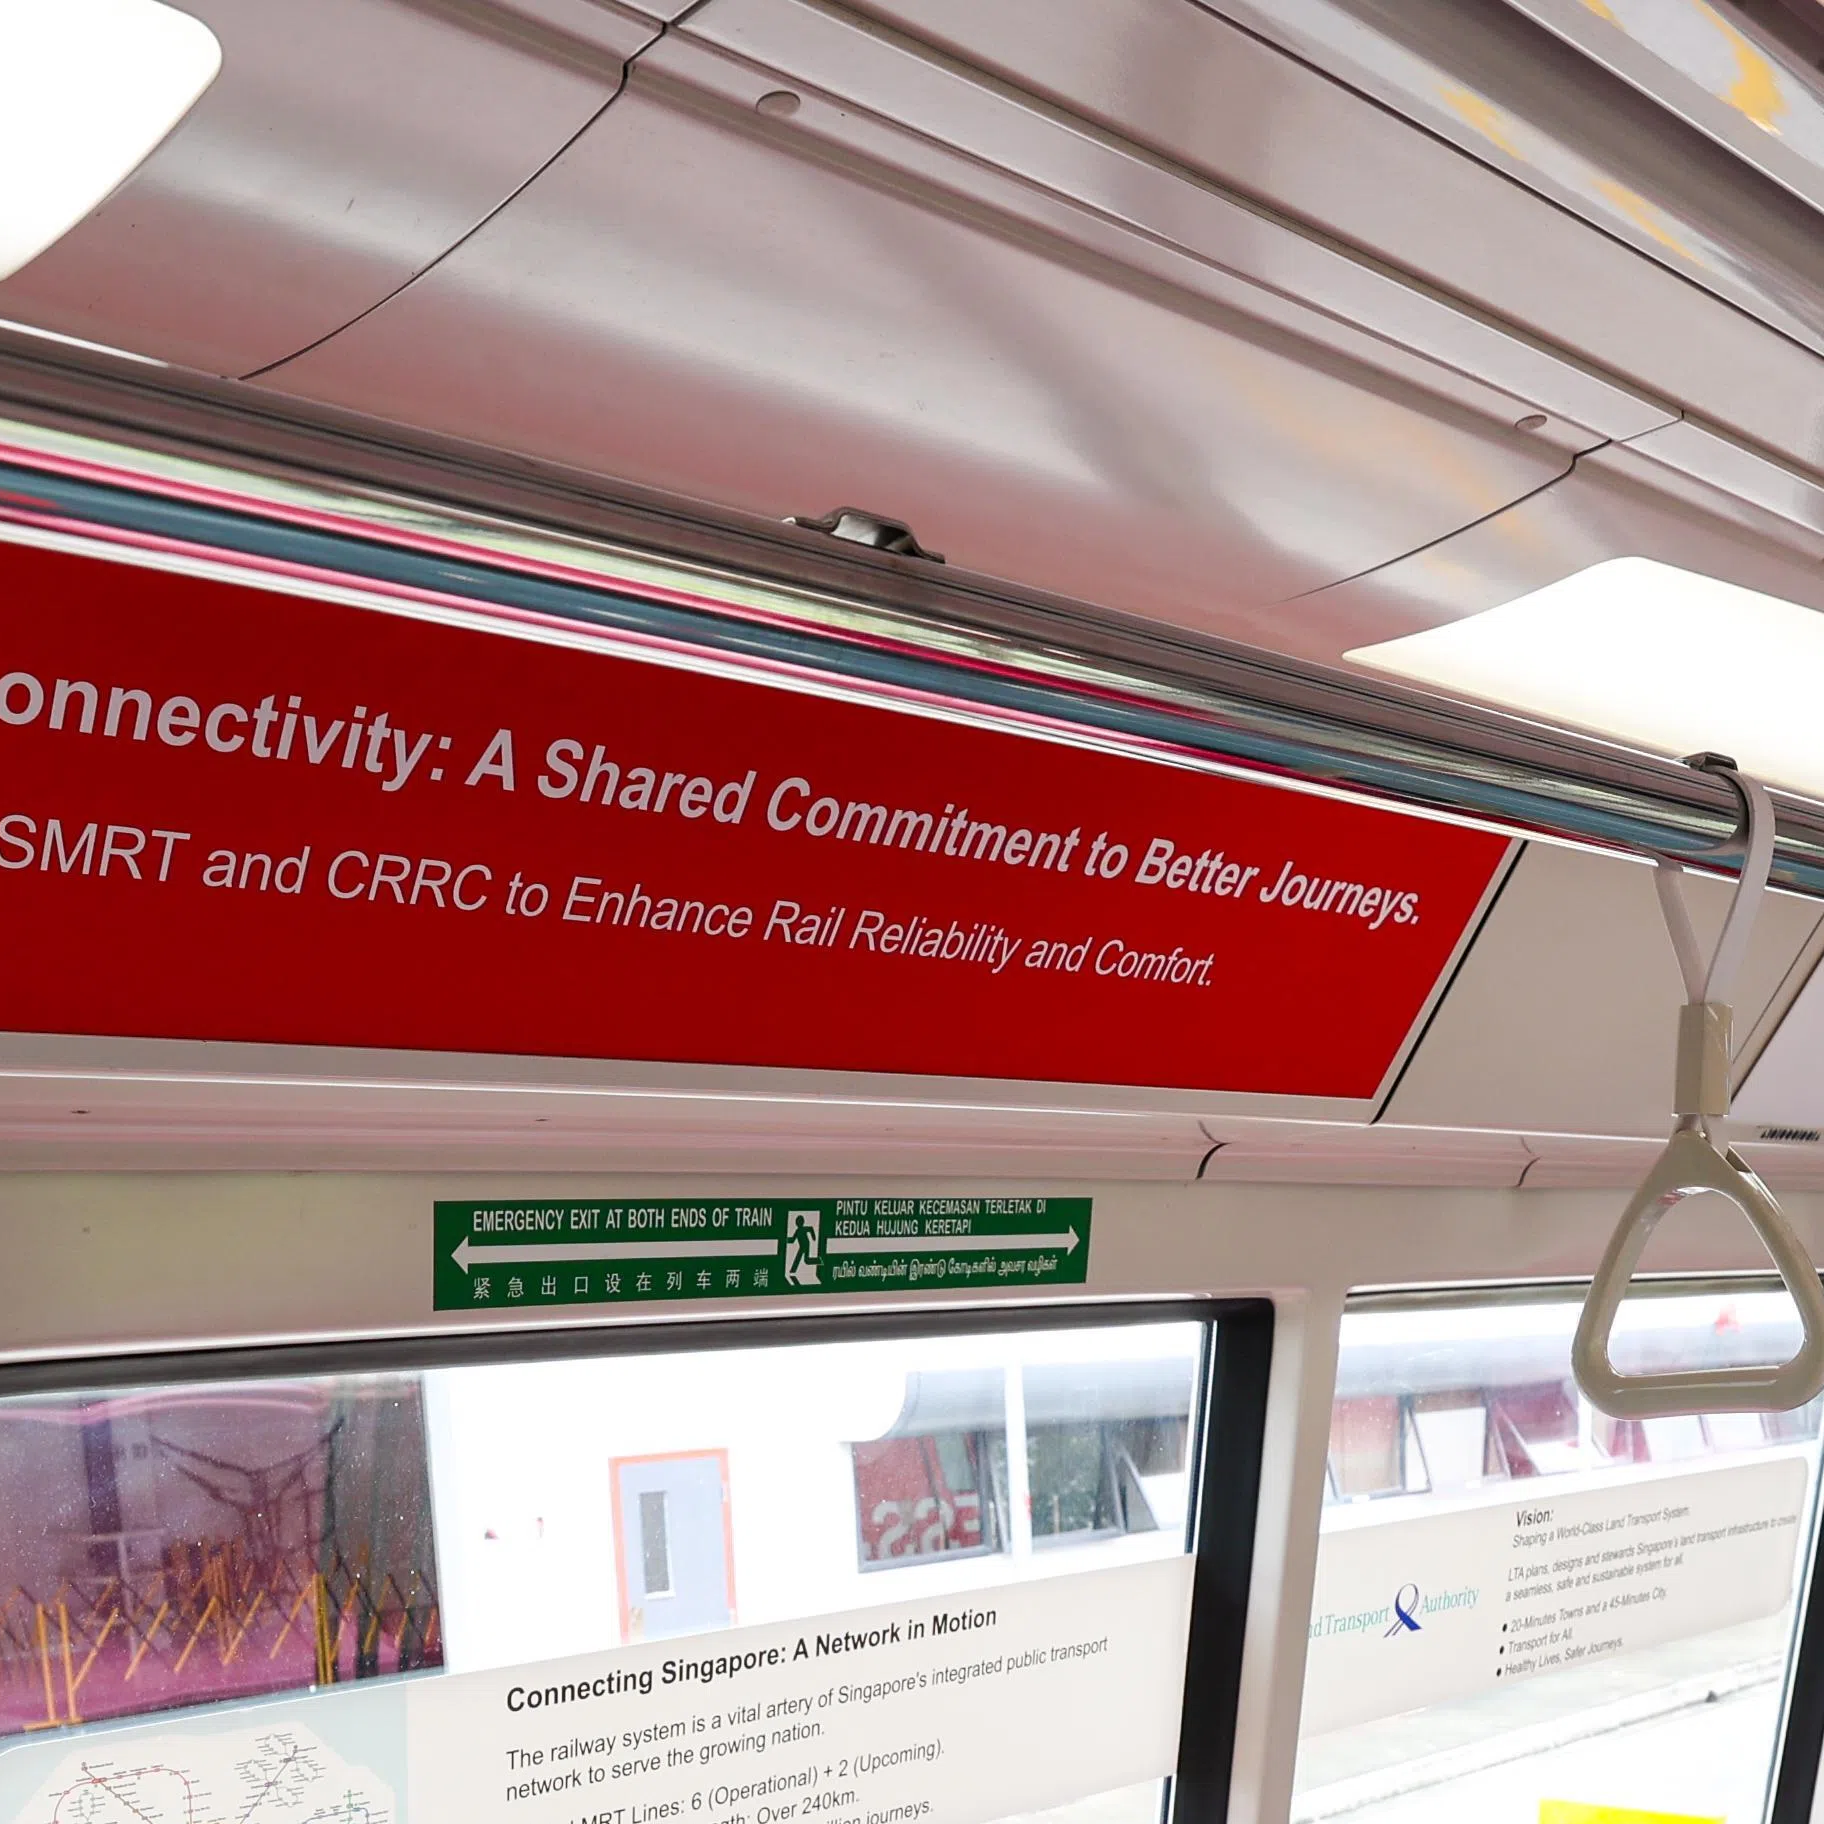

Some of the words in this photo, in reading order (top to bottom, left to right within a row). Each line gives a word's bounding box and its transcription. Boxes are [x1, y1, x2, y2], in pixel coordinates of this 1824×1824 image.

[466, 729, 518, 791] A
[536, 739, 756, 826] Shared
[766, 776, 1078, 875] Commitment
[1087, 828, 1128, 882] to
[1134, 837, 1259, 902] Better
[1260, 860, 1421, 930] Journeys.
[202, 842, 309, 895] and
[326, 848, 492, 913] CRRC
[506, 868, 549, 918] to
[562, 875, 752, 940] Enhance
[763, 899, 842, 950] Rail
[849, 908, 1022, 973] Reliability
[1024, 930, 1090, 974] and
[1093, 939, 1214, 987] Comfort.
[473, 1209, 564, 1232] EMERGENCY
[570, 1209, 600, 1229] EXIT
[605, 1208, 623, 1229] AT
[628, 1208, 664, 1229] BOTH
[671, 1208, 706, 1228] ENDS
[712, 1207, 729, 1227] OF
[735, 1207, 772, 1227] TRAIN
[835, 1219, 870, 1236] KEDUA
[877, 1219, 918, 1235] HUJUNG
[925, 1219, 972, 1234] KERETAPI
[836, 1200, 868, 1216] PINTU
[874, 1200, 915, 1216] KELUAR
[919, 1199, 980, 1215] KECEMASAN
[985, 1199, 1032, 1214] TERLETAK
[1036, 1199, 1046, 1213] DI
[1516, 1509, 1554, 1528] Vision:
[1325, 1606, 1390, 1635] Transport
[1420, 1585, 1480, 1615] Authority
[507, 1670, 653, 1712] Connecting
[661, 1645, 786, 1685] Singapore:
[793, 1638, 808, 1661] A
[815, 1622, 901, 1657] Network
[907, 1619, 925, 1640] in
[932, 1608, 997, 1636] Motion
[507, 1749, 544, 1770] The
[550, 1735, 616, 1762] railway
[622, 1720, 687, 1749] system
[691, 1715, 706, 1733] is
[711, 1713, 722, 1729] a
[727, 1702, 761, 1726] vital
[766, 1696, 813, 1719] artery
[818, 1688, 835, 1708] of
[837, 1672, 927, 1705] Singapore's
[931, 1656, 1003, 1685] integrated
[1007, 1649, 1047, 1674] public
[1050, 1636, 1108, 1663] transport
[506, 1769, 583, 1802] network
[588, 1766, 605, 1784] to
[611, 1754, 661, 1779] serve
[667, 1747, 694, 1768] the
[699, 1733, 766, 1764] growing
[771, 1720, 825, 1746] nation.
[631, 1798, 685, 1824] Lines:
[691, 1792, 702, 1811] 6
[707, 1767, 818, 1811] (Operational)
[823, 1763, 834, 1778] +
[838, 1760, 849, 1779] 2
[852, 1739, 945, 1778] (Upcoming).
[802, 1787, 860, 1815] 240km.
